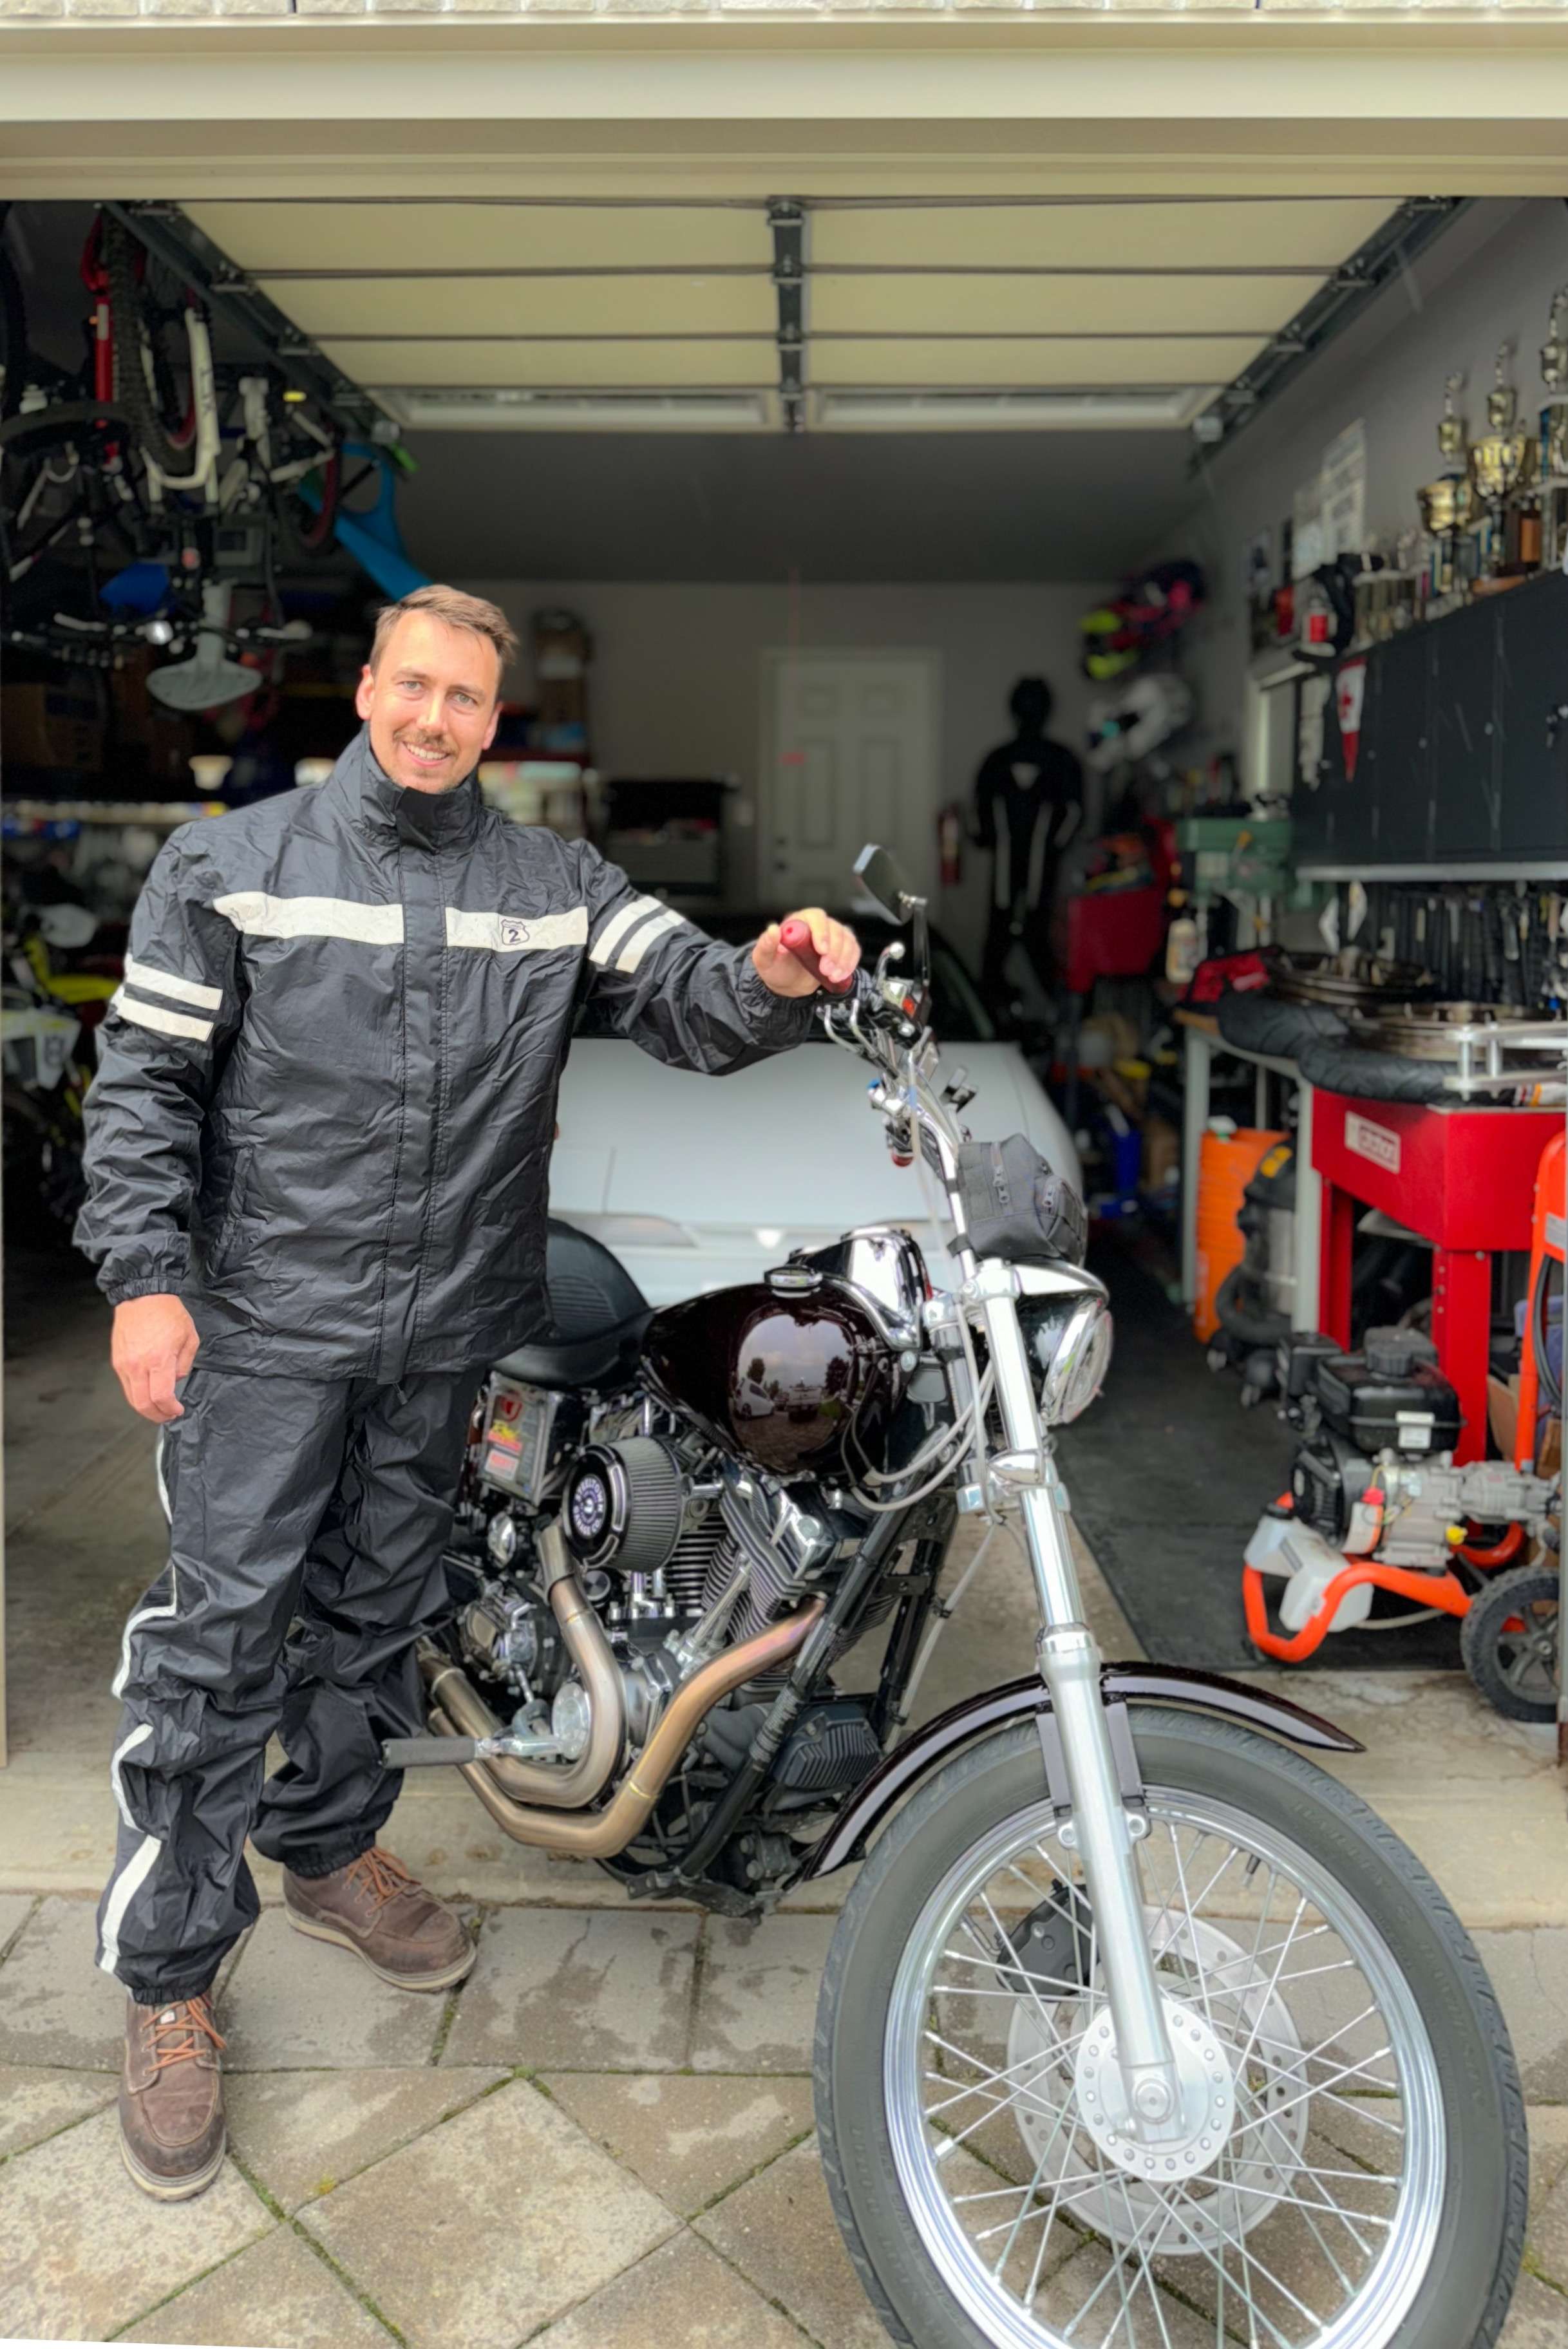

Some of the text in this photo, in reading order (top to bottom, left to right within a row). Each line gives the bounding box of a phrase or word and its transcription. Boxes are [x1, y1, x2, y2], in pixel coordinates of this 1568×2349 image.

[509, 929, 521, 943] 2
[575, 1477, 603, 1513] STEELTOWN
[572, 1505, 590, 1536] GARAGE
